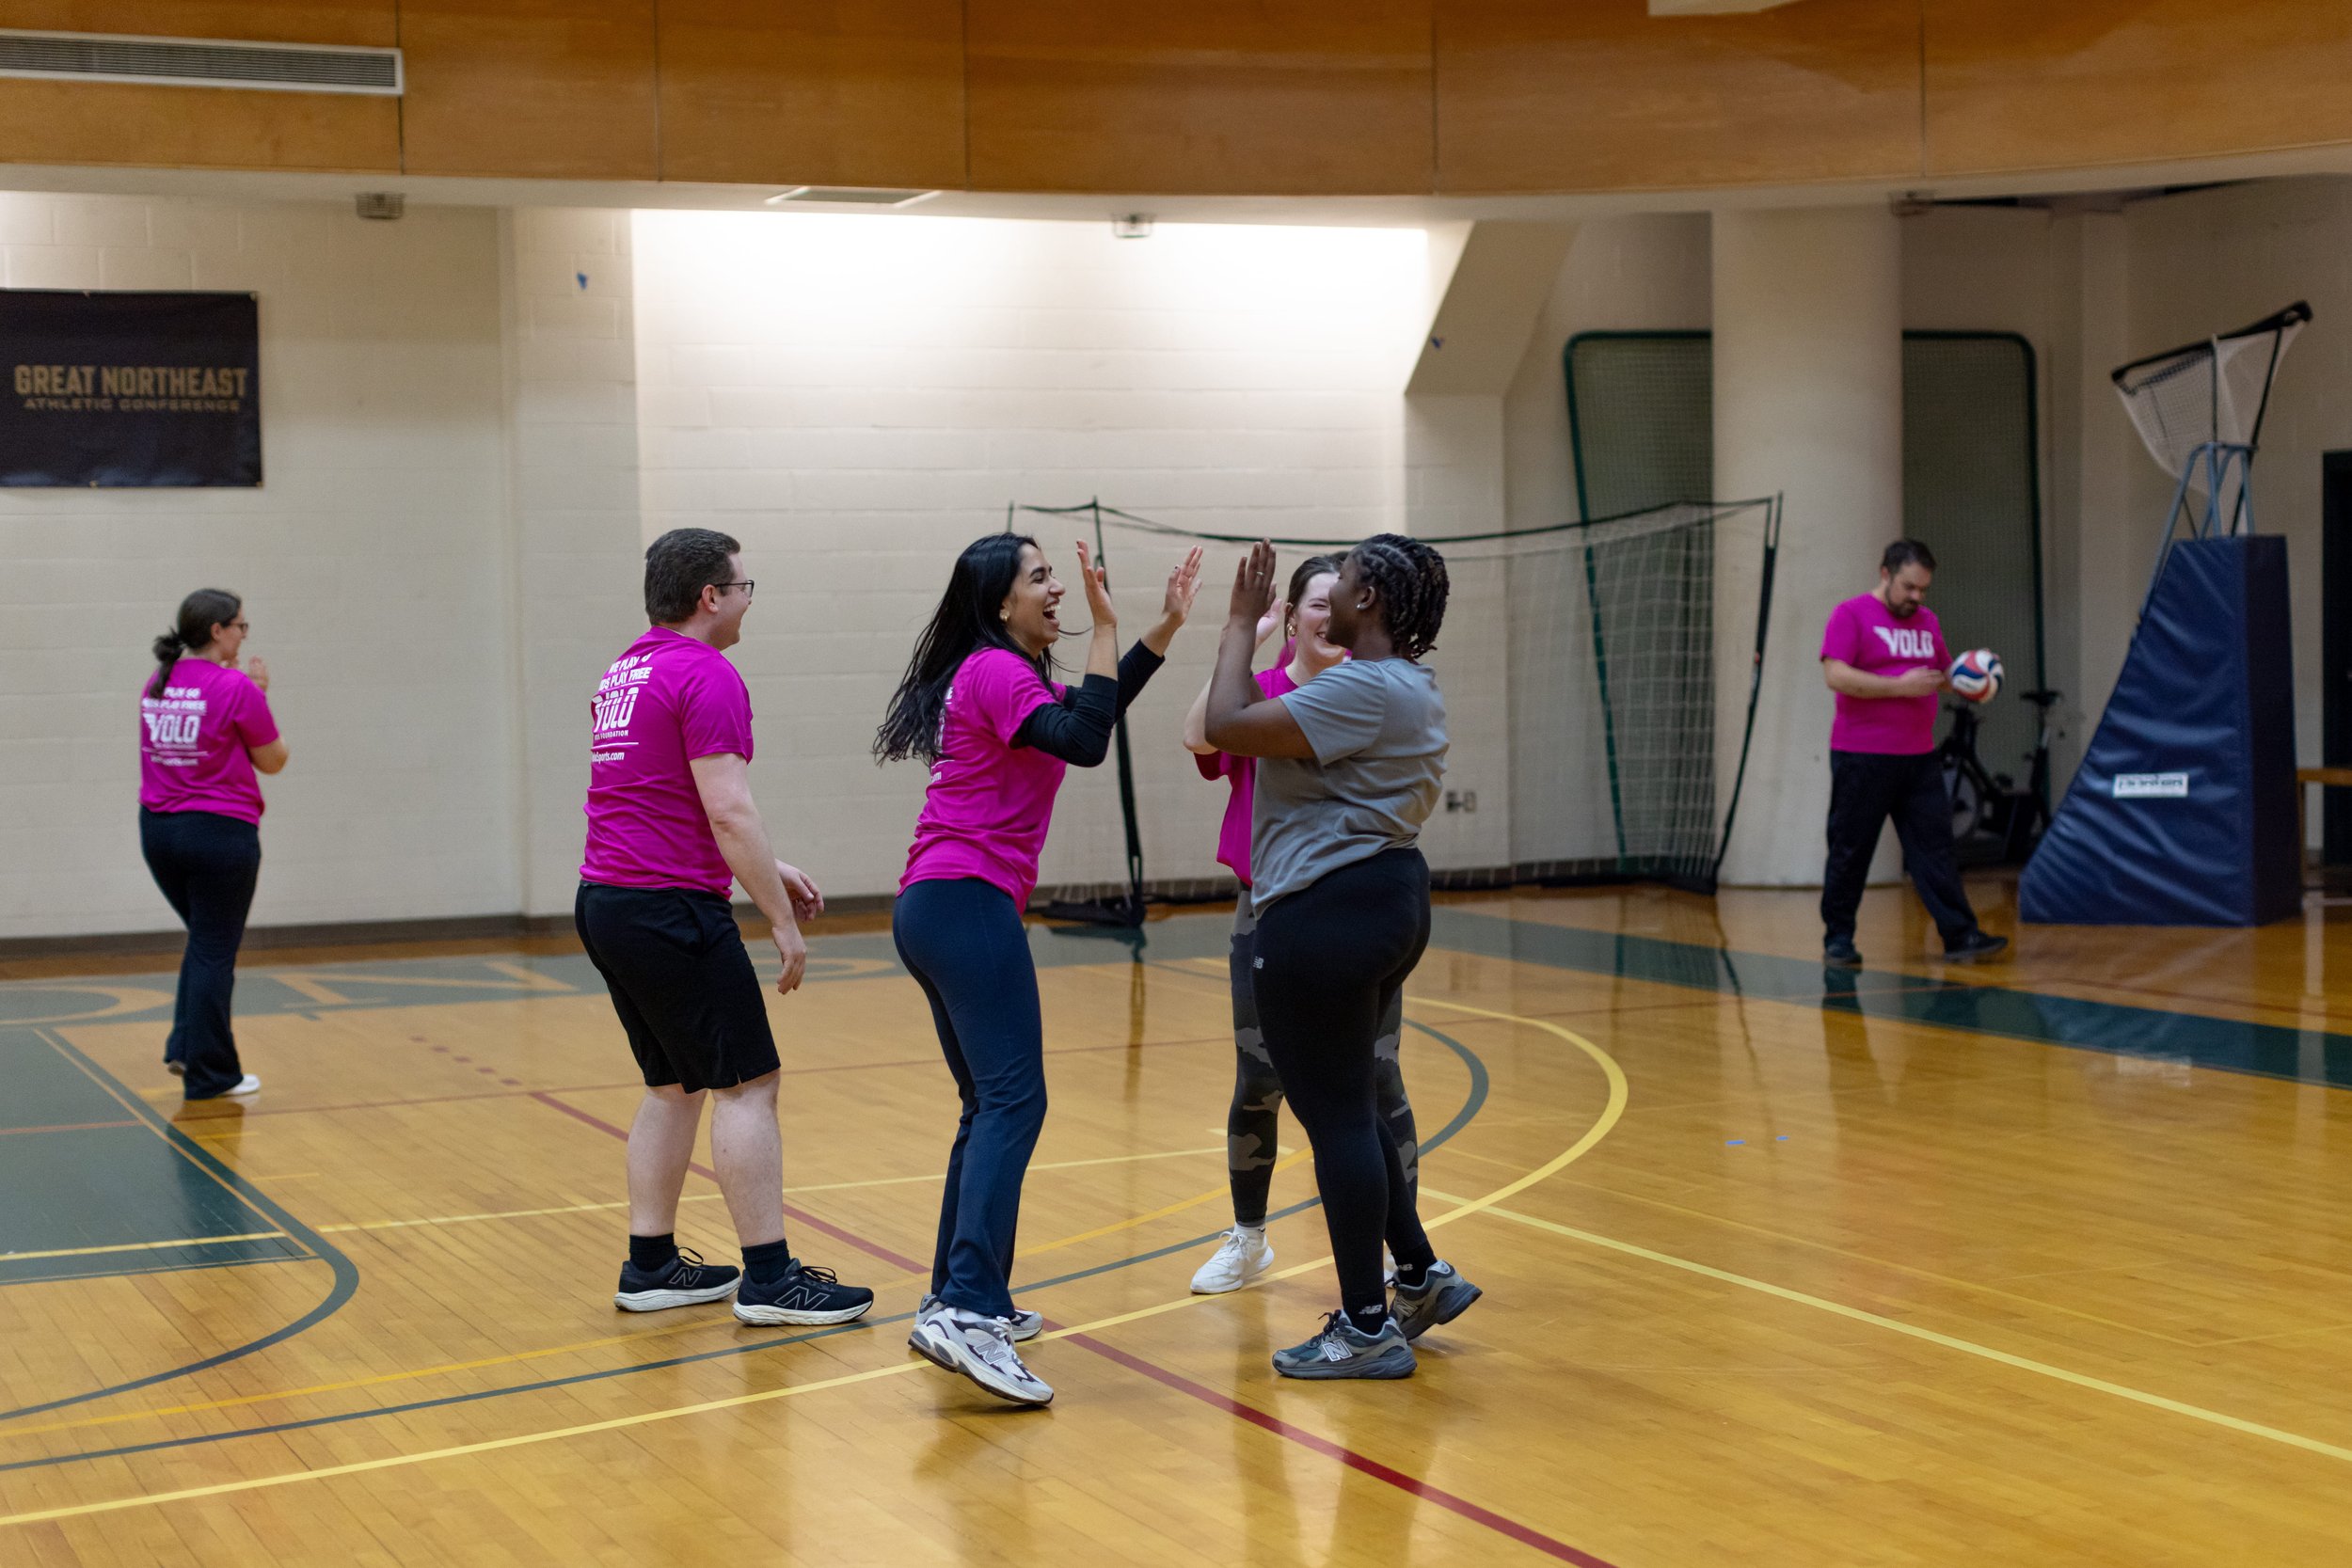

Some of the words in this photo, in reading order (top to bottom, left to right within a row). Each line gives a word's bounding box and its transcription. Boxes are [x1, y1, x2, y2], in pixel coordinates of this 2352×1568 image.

[13, 364, 97, 395] GREAT
[100, 366, 248, 398] NORTHEAST
[23, 398, 113, 412] ATHLETIC
[119, 399, 241, 413] CONFERENCE
[1872, 625, 1935, 657] VOLO
[620, 657, 641, 671] PLAY
[611, 672, 628, 688] PLAY
[628, 667, 653, 681] FREE
[142, 713, 201, 744] VOLO
[600, 730, 629, 739] FOUNDATION
